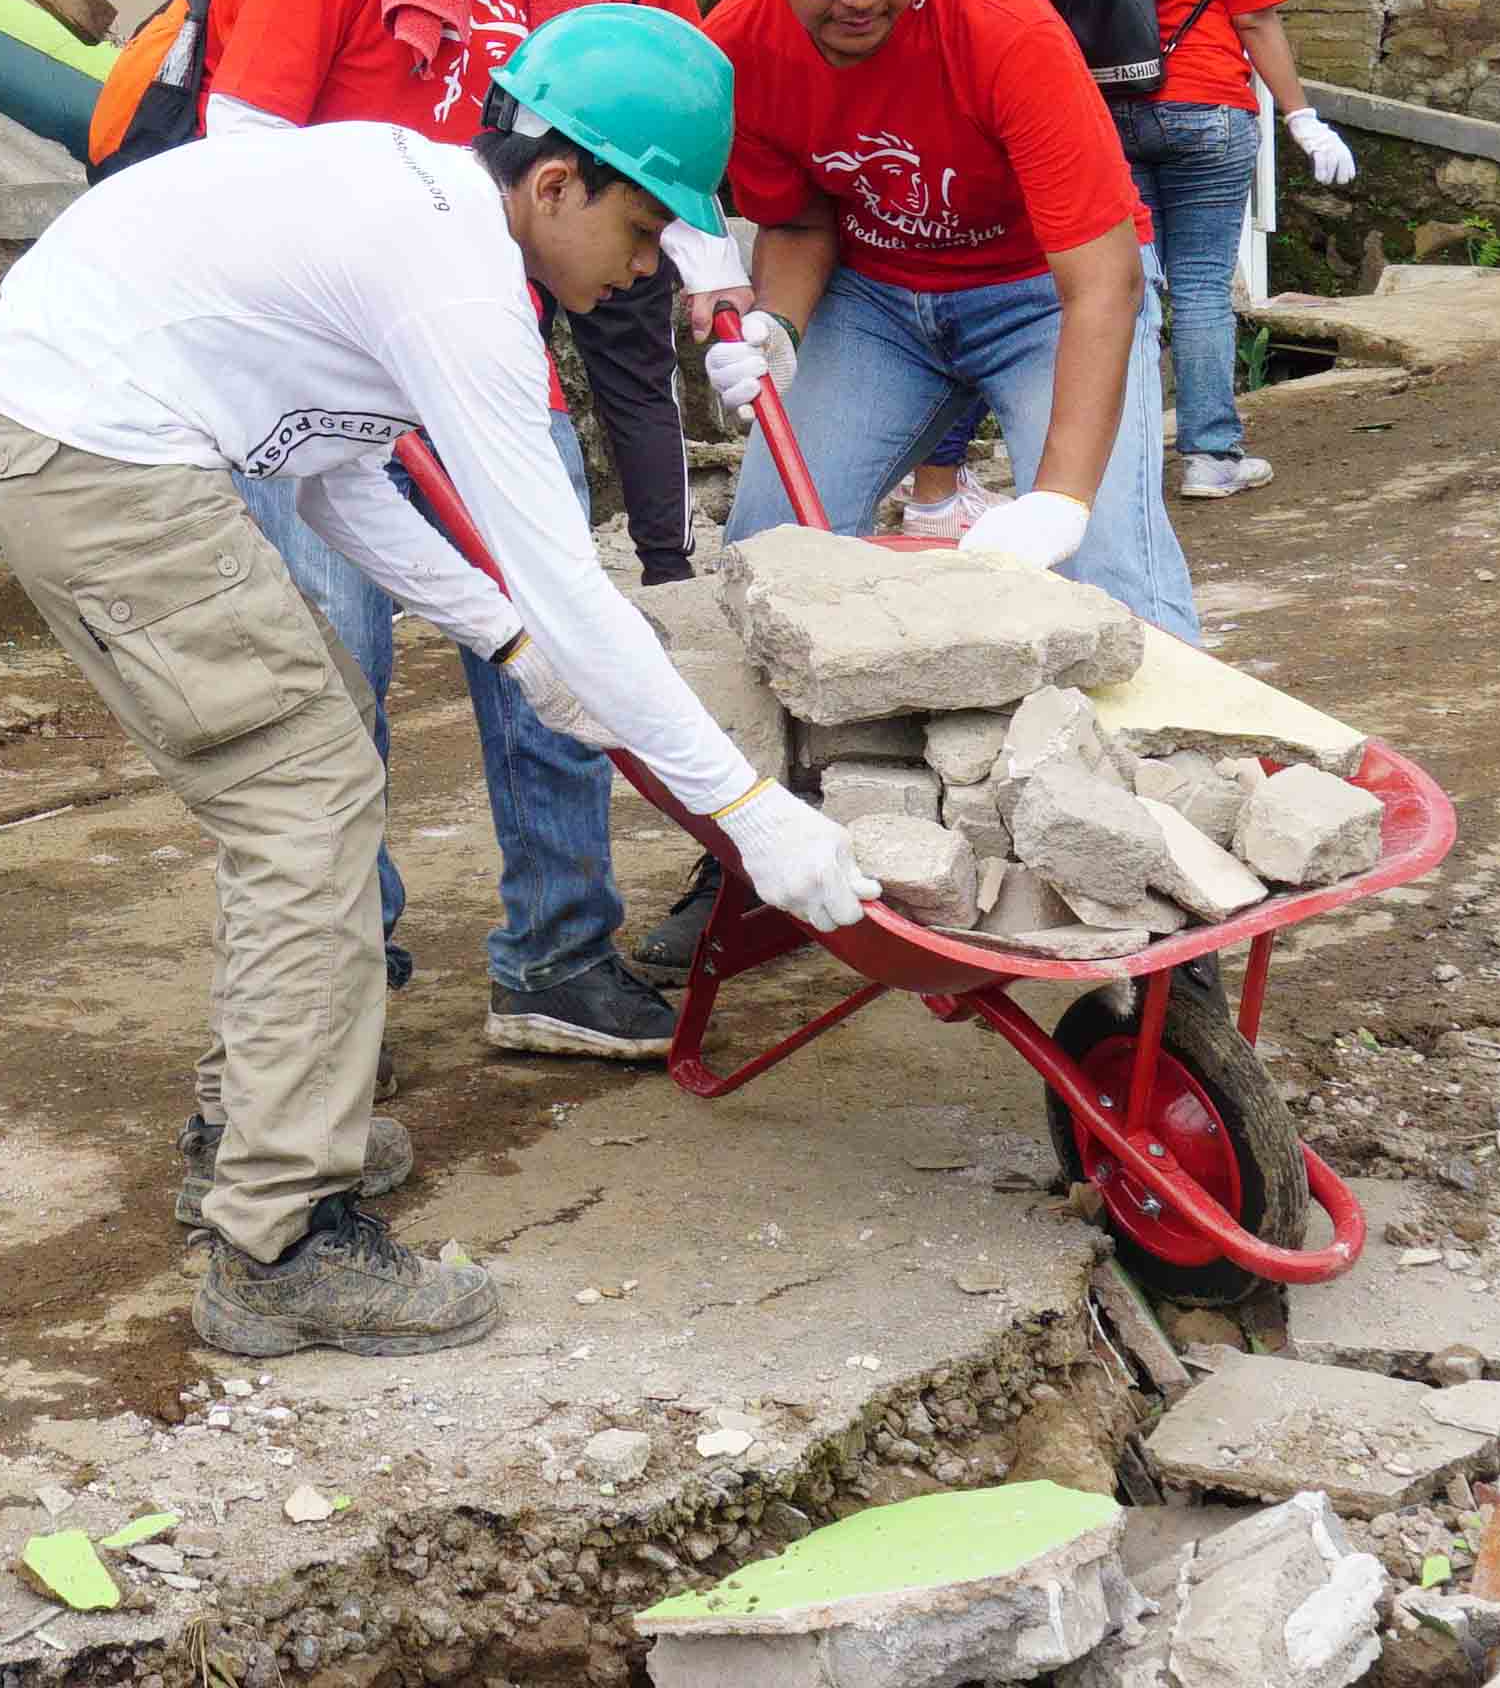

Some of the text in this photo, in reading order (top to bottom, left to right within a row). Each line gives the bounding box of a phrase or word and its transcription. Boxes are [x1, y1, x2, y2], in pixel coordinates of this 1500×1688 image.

[846, 214, 908, 250] Peduli
[319, 416, 407, 439] GERA
[246, 416, 313, 478] POSK
